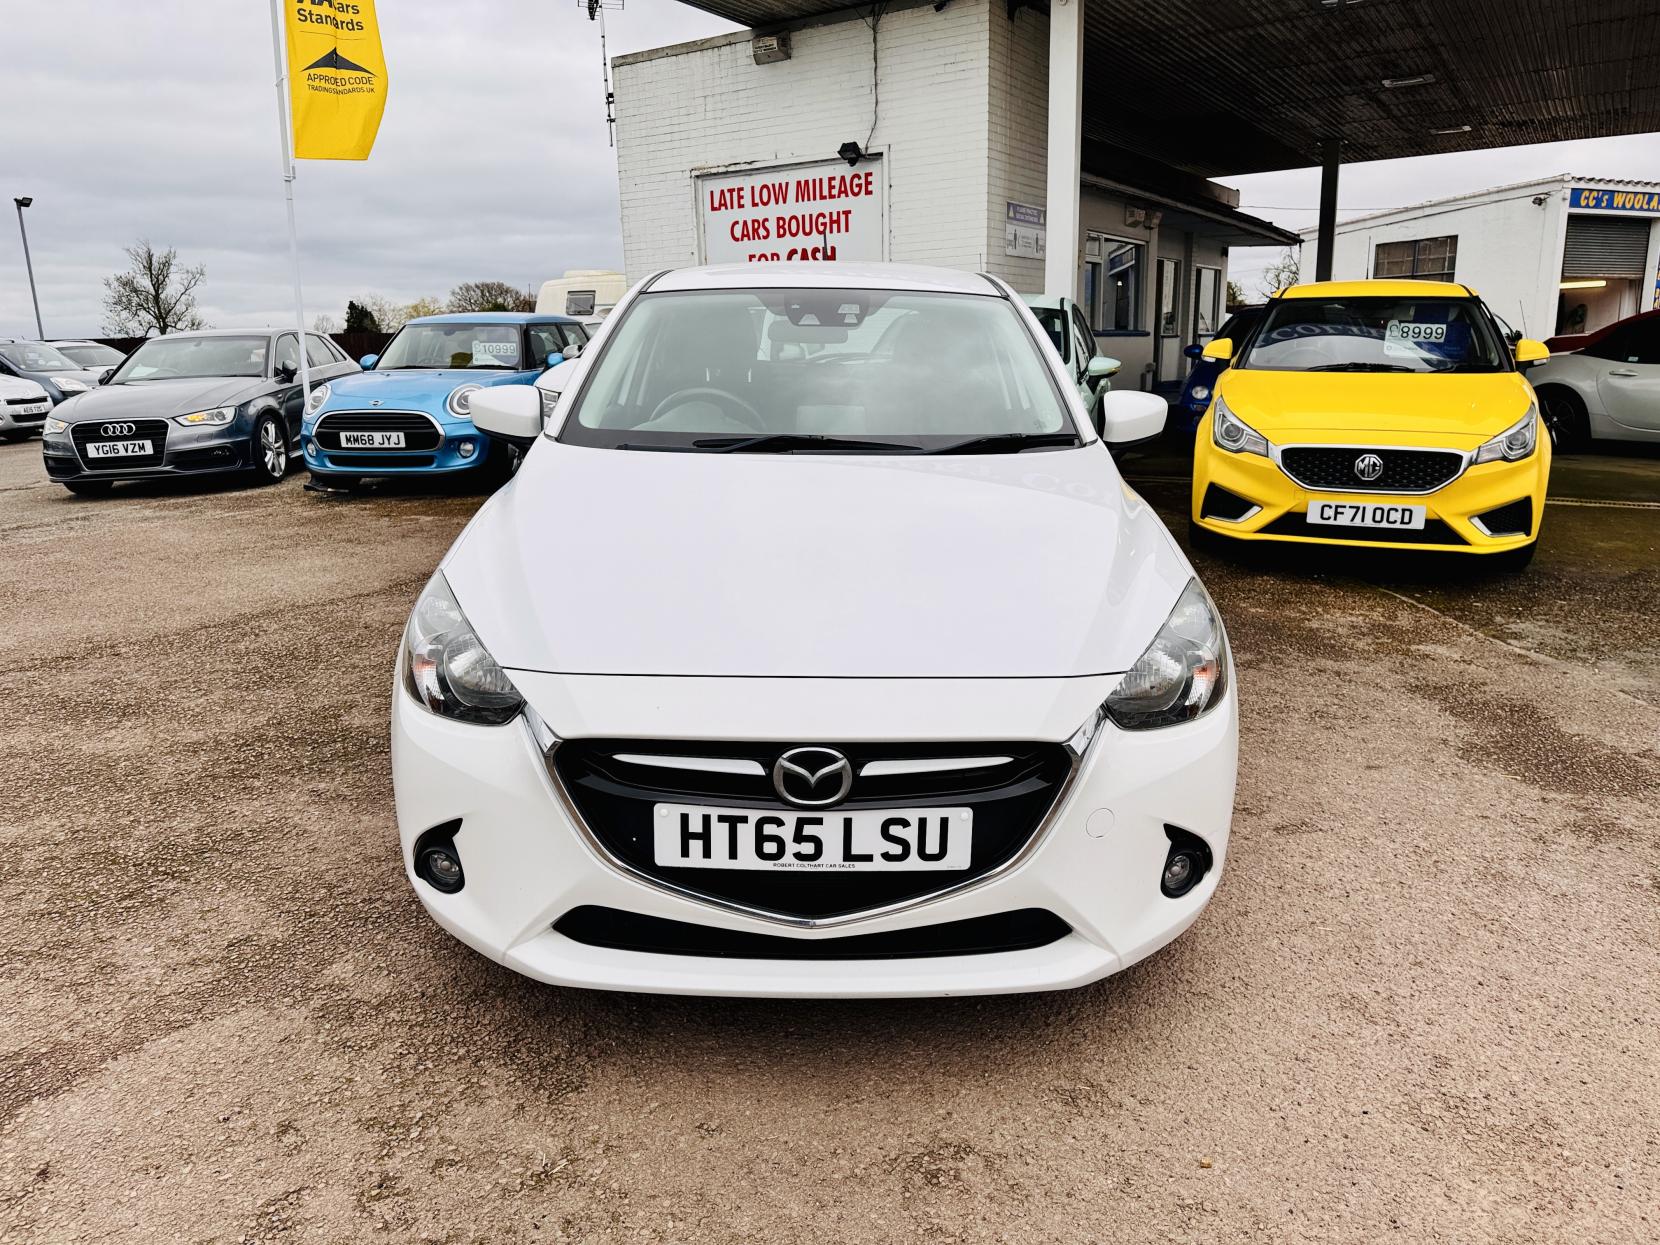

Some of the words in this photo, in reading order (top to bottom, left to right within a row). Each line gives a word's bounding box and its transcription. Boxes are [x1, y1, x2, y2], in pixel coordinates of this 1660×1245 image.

[333, 2, 360, 15] ars
[348, 76, 374, 86] CODE
[710, 187, 745, 211] LATE
[751, 182, 789, 207] LOW
[795, 172, 873, 203] MILEAGE
[1581, 191, 1609, 207] CC's
[1613, 192, 1660, 210] WOOLA
[730, 218, 770, 242] CARS
[776, 210, 852, 238] BOUGHT
[93, 444, 120, 456] YG16
[121, 442, 147, 454] VZM
[345, 434, 375, 446] MM68
[378, 434, 401, 446] JYJ
[1357, 455, 1381, 478] MG
[1320, 504, 1367, 523] CF71
[1371, 506, 1414, 525] OCD
[679, 812, 824, 862] HT65
[842, 816, 950, 862] LSU
